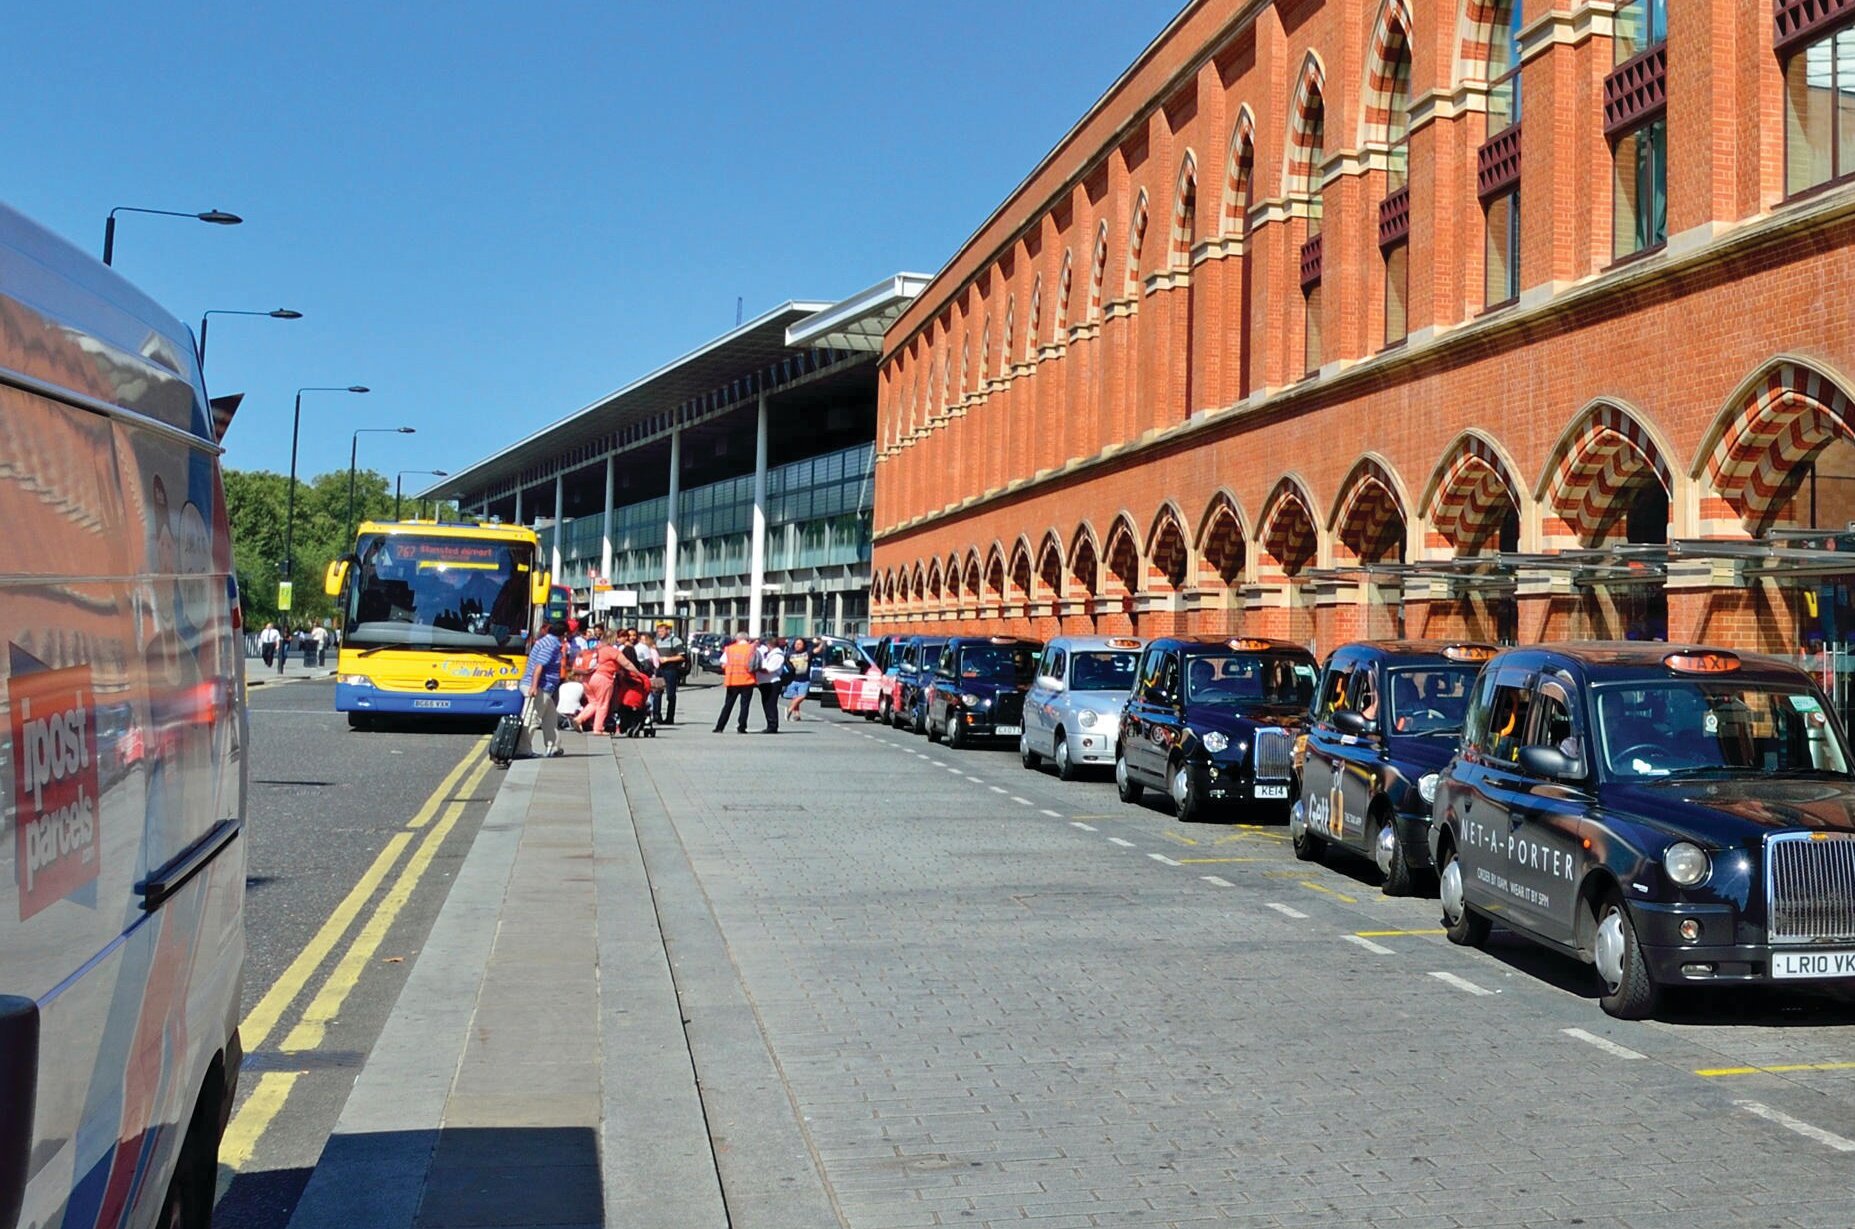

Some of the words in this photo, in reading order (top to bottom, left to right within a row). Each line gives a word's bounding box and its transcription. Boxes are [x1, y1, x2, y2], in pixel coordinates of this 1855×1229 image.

[397, 545, 416, 558] 767
[1687, 656, 1729, 670] TAXI
[1261, 786, 1284, 796] KE14
[1309, 792, 1329, 836] Gett
[26, 784, 94, 892] parcels
[1460, 818, 1574, 882] NET-A-PORTER
[1477, 867, 1490, 883] ORDER
[1491, 872, 1497, 885] BY
[1509, 881, 1525, 899] WEAR
[1525, 887, 1531, 901] IT
[1531, 889, 1538, 903] BY
[1538, 892, 1550, 909] 5PM
[1786, 955, 1828, 974] LR10
